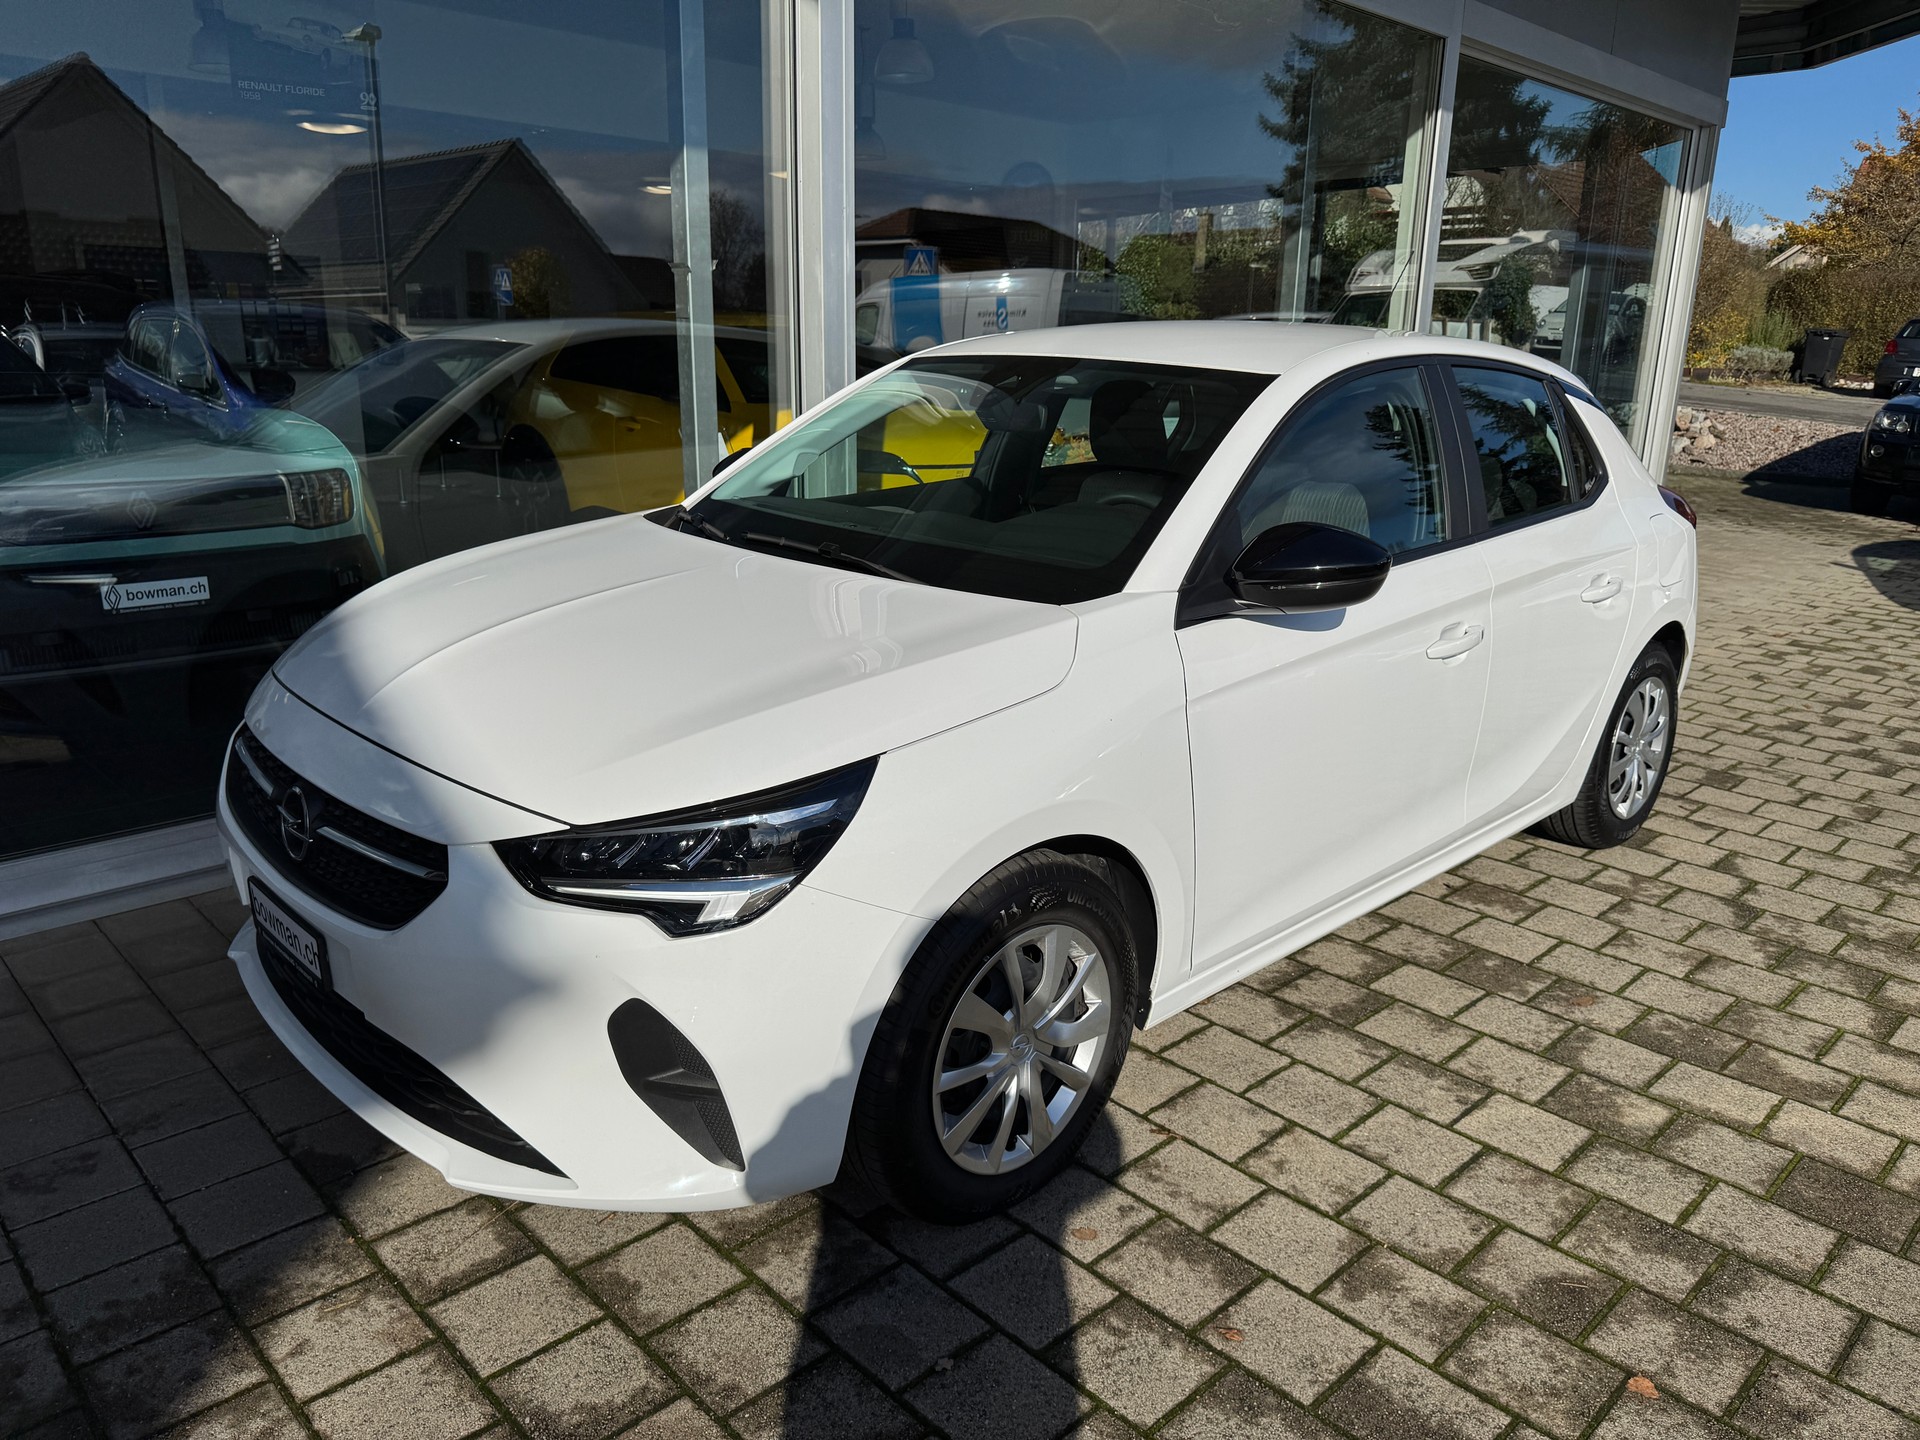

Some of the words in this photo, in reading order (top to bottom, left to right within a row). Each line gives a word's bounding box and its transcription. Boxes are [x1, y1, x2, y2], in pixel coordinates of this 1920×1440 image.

[238, 80, 283, 93] RENAULT
[285, 85, 326, 97] FLORIDE
[240, 90, 262, 101] 1958
[125, 581, 207, 601] bowman.ch
[251, 887, 320, 970] bowman.ch
